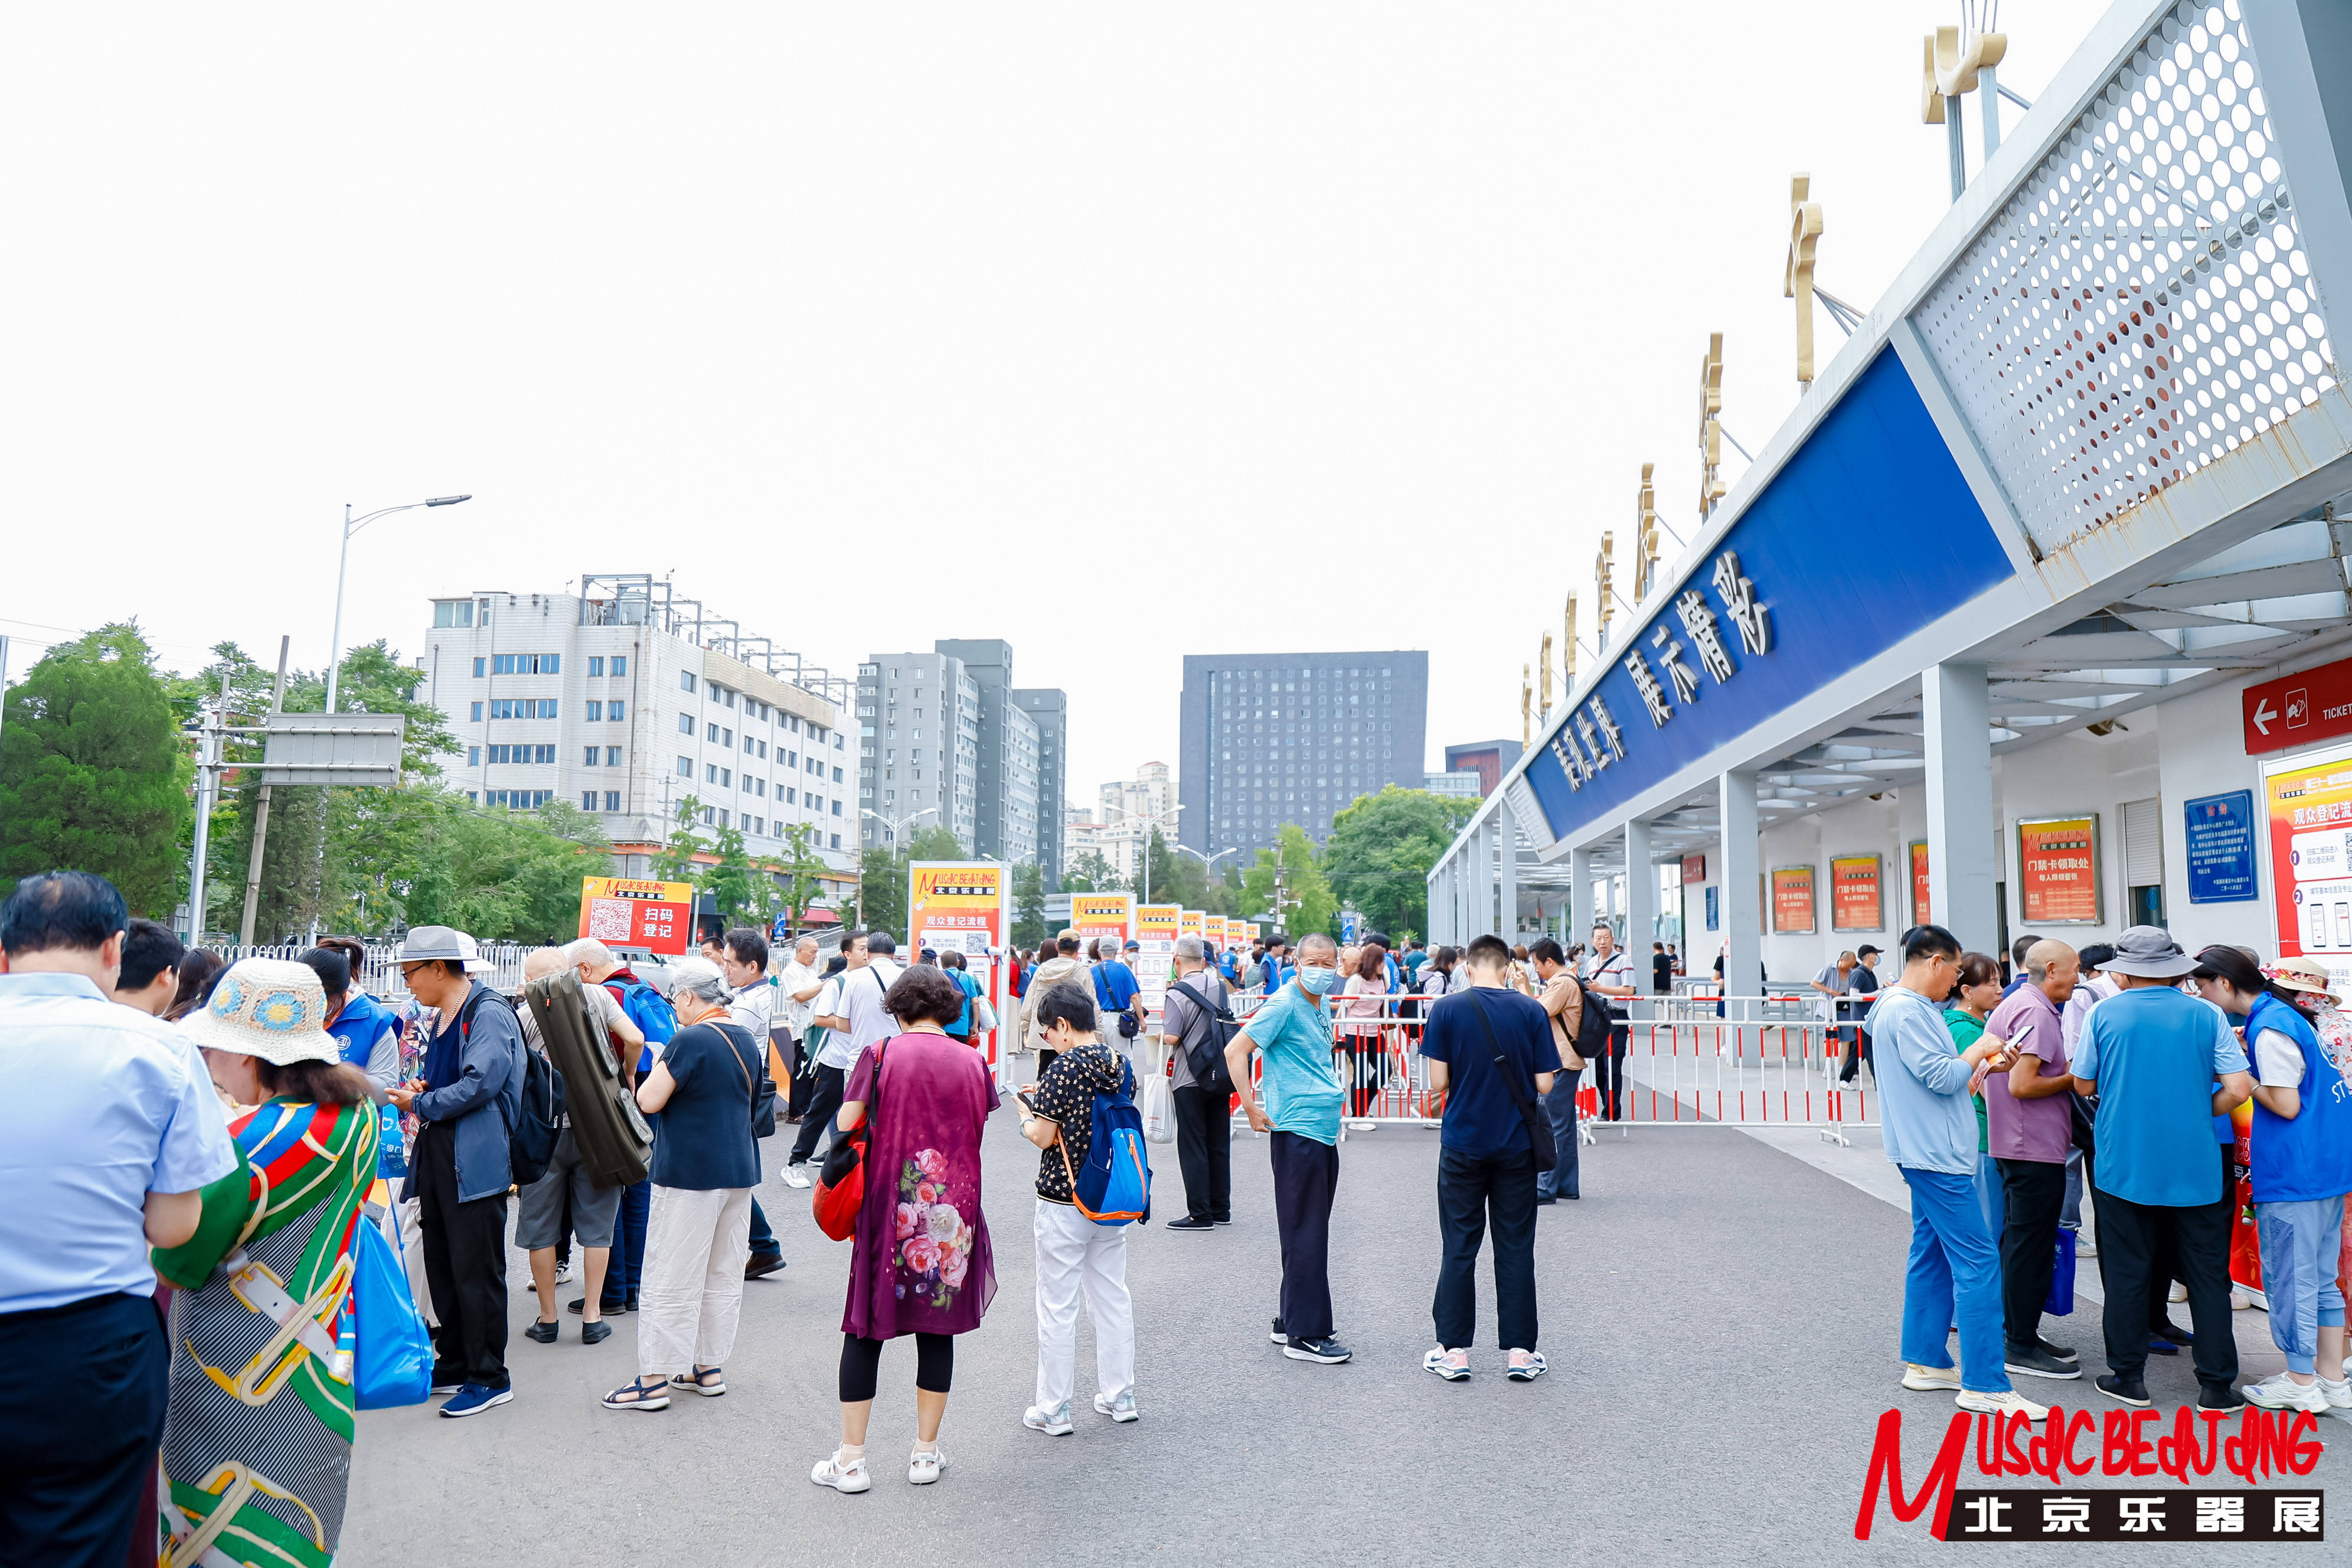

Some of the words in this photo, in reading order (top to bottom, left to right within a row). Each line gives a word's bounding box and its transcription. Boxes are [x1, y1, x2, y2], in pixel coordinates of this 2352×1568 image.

[1625, 550, 1773, 730] 展示精彩
[2322, 703, 2352, 720] TICKET
[2294, 801, 2352, 825] 观众登记流
[2028, 858, 2089, 871] 门禁卡领取处
[645, 907, 674, 922] 扫码
[926, 916, 986, 926] 观众登记流程
[643, 923, 672, 939] 登记
